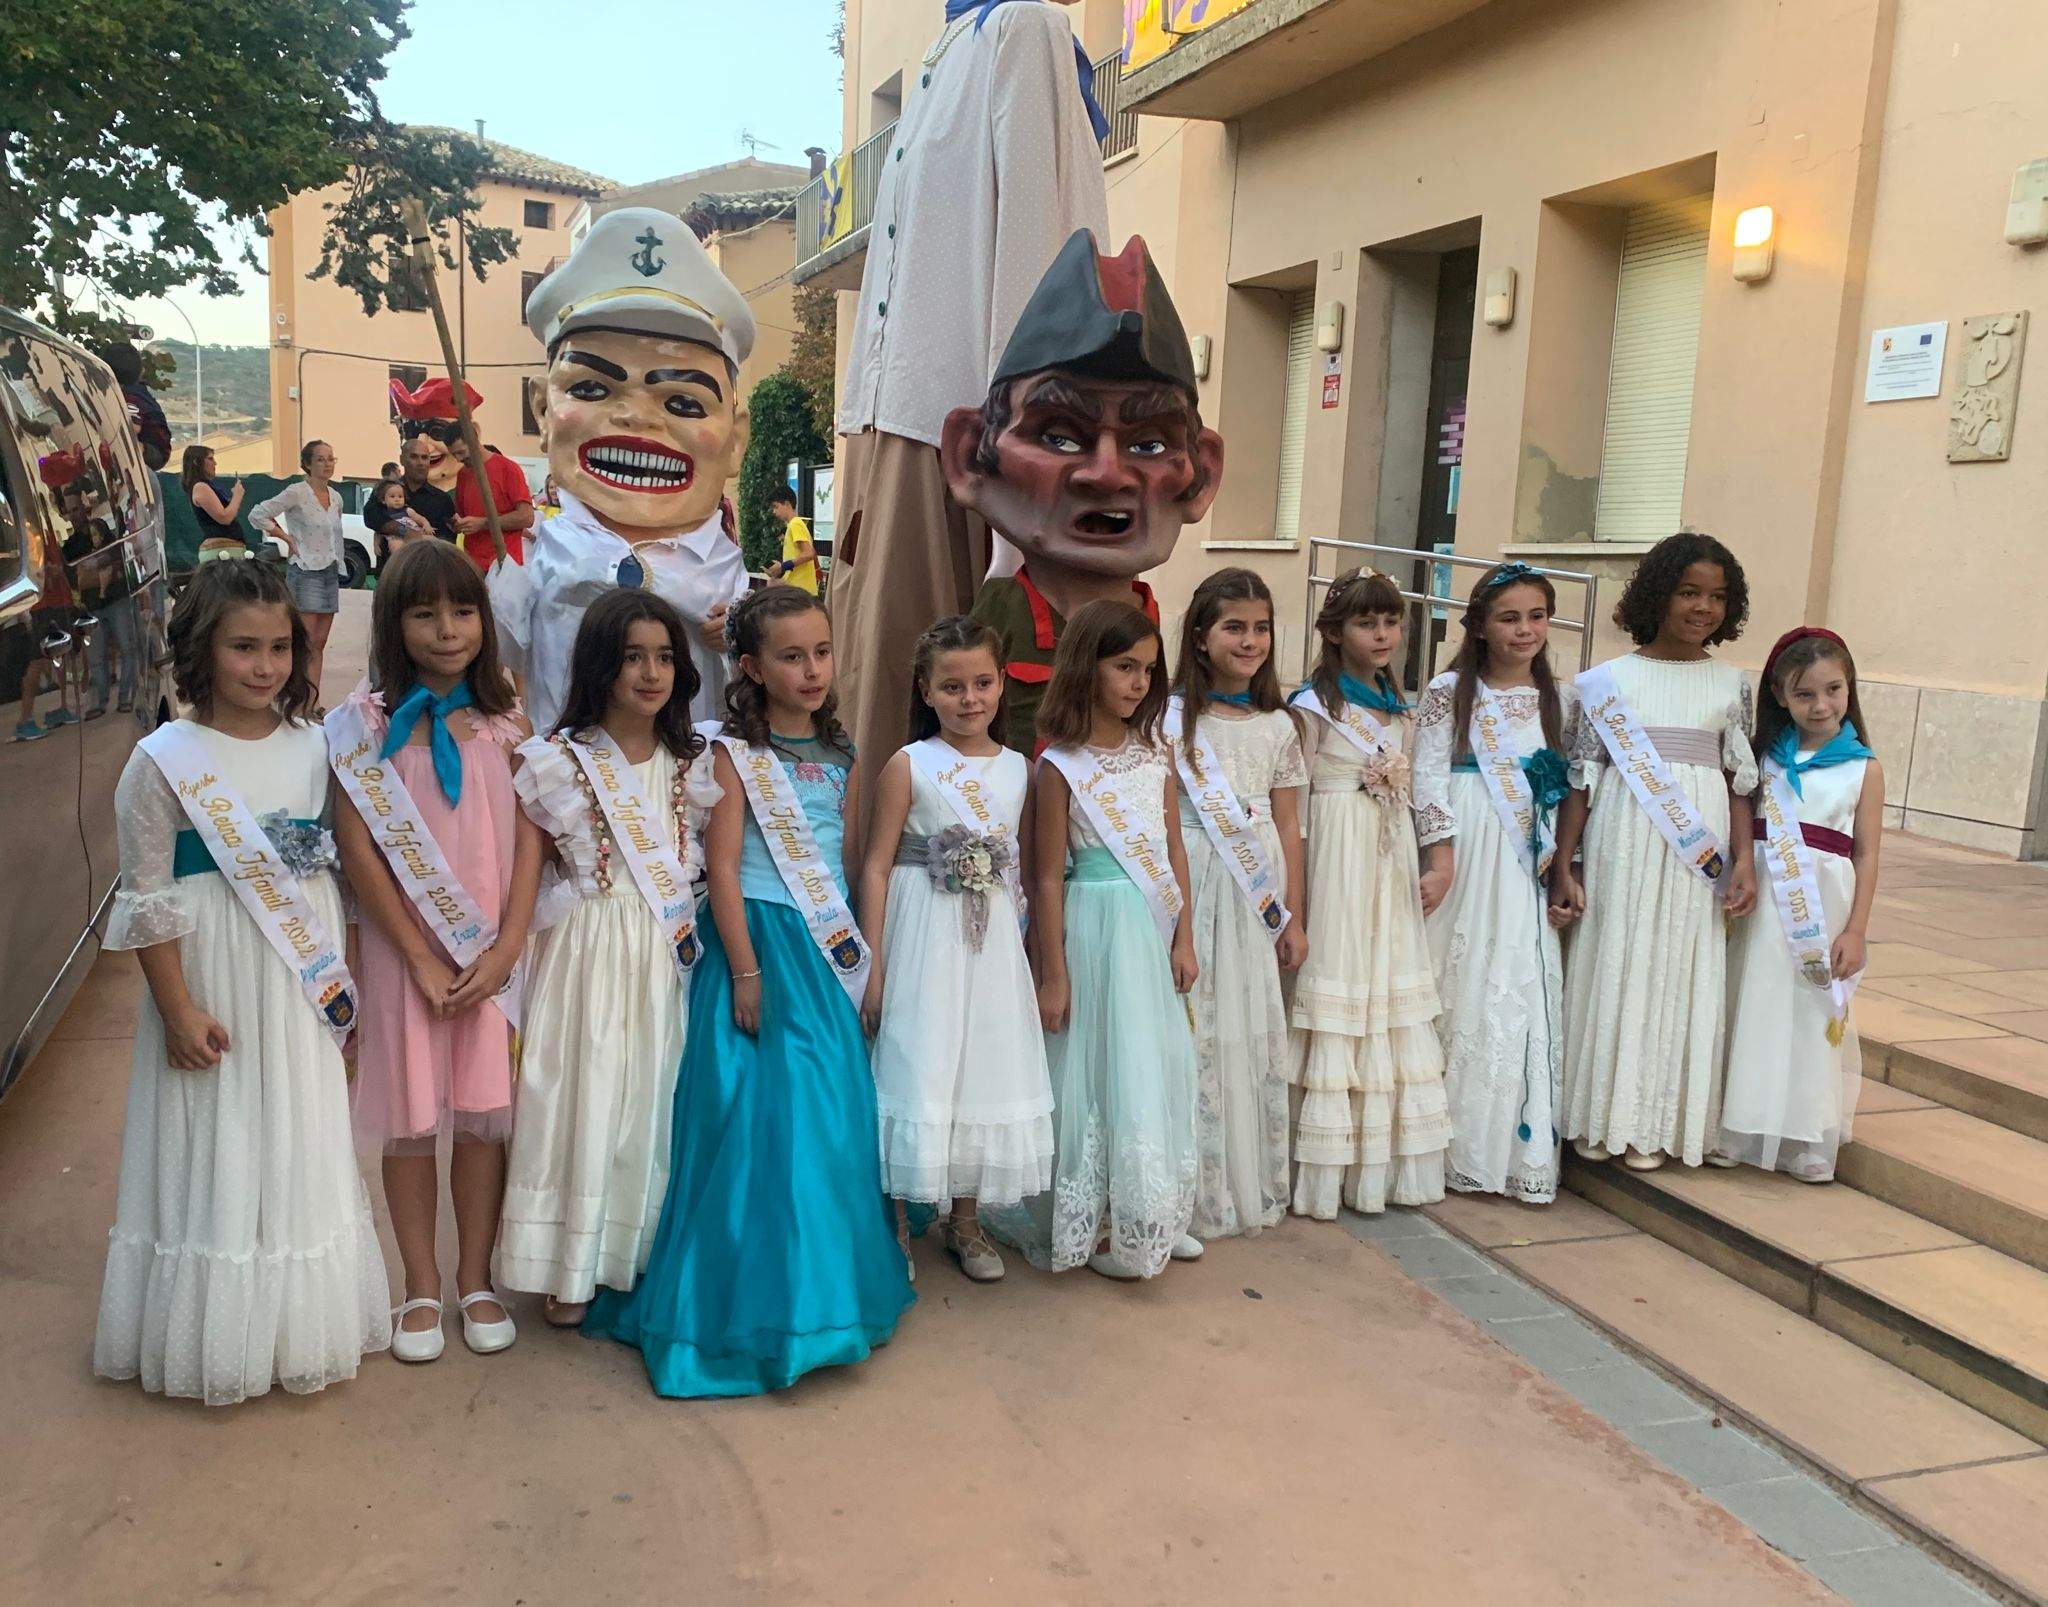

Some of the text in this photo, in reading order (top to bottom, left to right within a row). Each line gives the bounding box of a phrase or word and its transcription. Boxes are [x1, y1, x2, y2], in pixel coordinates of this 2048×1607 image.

[1590, 695, 1616, 719] Ayerbe
[179, 773, 218, 798] Ayerbe
[335, 743, 371, 770] Ayerbe
[937, 761, 967, 785] Ayerbe
[1077, 771, 1105, 794] Ayerbe
[1475, 715, 1499, 752] Reina
[1489, 757, 1527, 803] Infantil
[1605, 713, 1692, 831] Reina Infantil 2022
[586, 746, 678, 901] Reina Infantil 2022
[747, 756, 829, 906] Reina Infantil 2022
[955, 779, 991, 822] Reina
[1094, 791, 1129, 832] Reina
[1124, 832, 1168, 882] Infantil
[1201, 790, 1242, 838] Infantil
[1232, 842, 1259, 875] 2022
[200, 797, 317, 958] Reina Infantil 2022
[353, 767, 465, 925] Reina Infantil 2022
[815, 908, 839, 925] Paula
